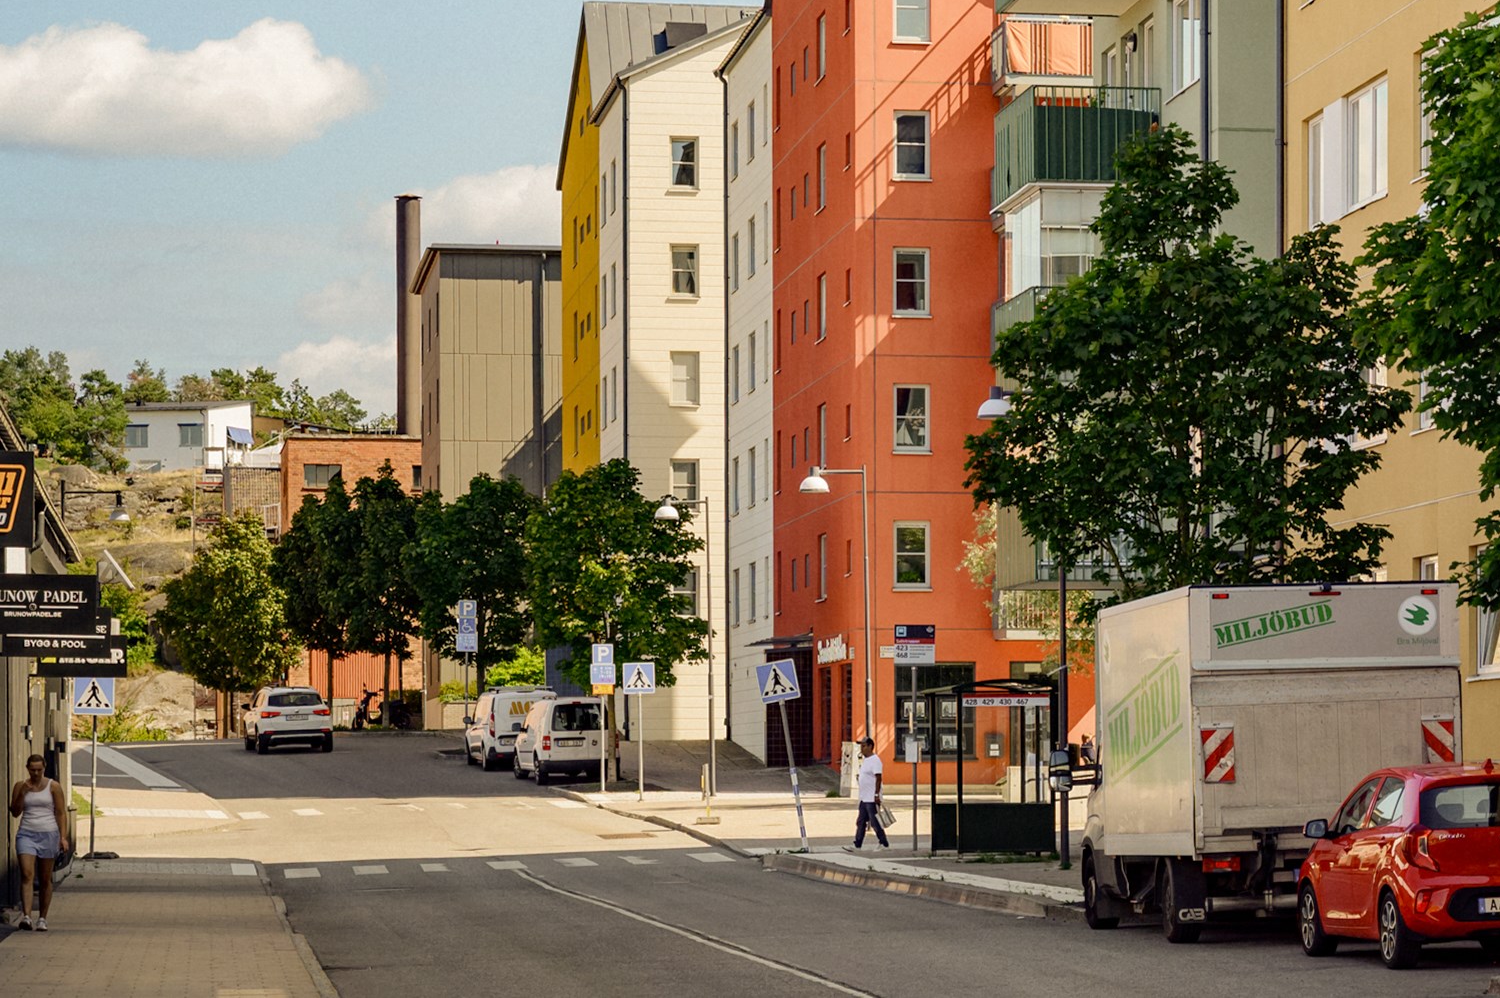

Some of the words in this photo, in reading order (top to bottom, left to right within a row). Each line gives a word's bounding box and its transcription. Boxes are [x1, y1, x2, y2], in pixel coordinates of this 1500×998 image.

[43, 591, 87, 603] PADEL
[463, 602, 474, 615] P
[1214, 603, 1333, 645] MILJÖBUD
[23, 639, 51, 648] BYGG
[52, 640, 60, 648] &
[61, 640, 87, 649] POOL
[597, 646, 610, 662] P
[1107, 661, 1181, 779] MILJÖBUD
